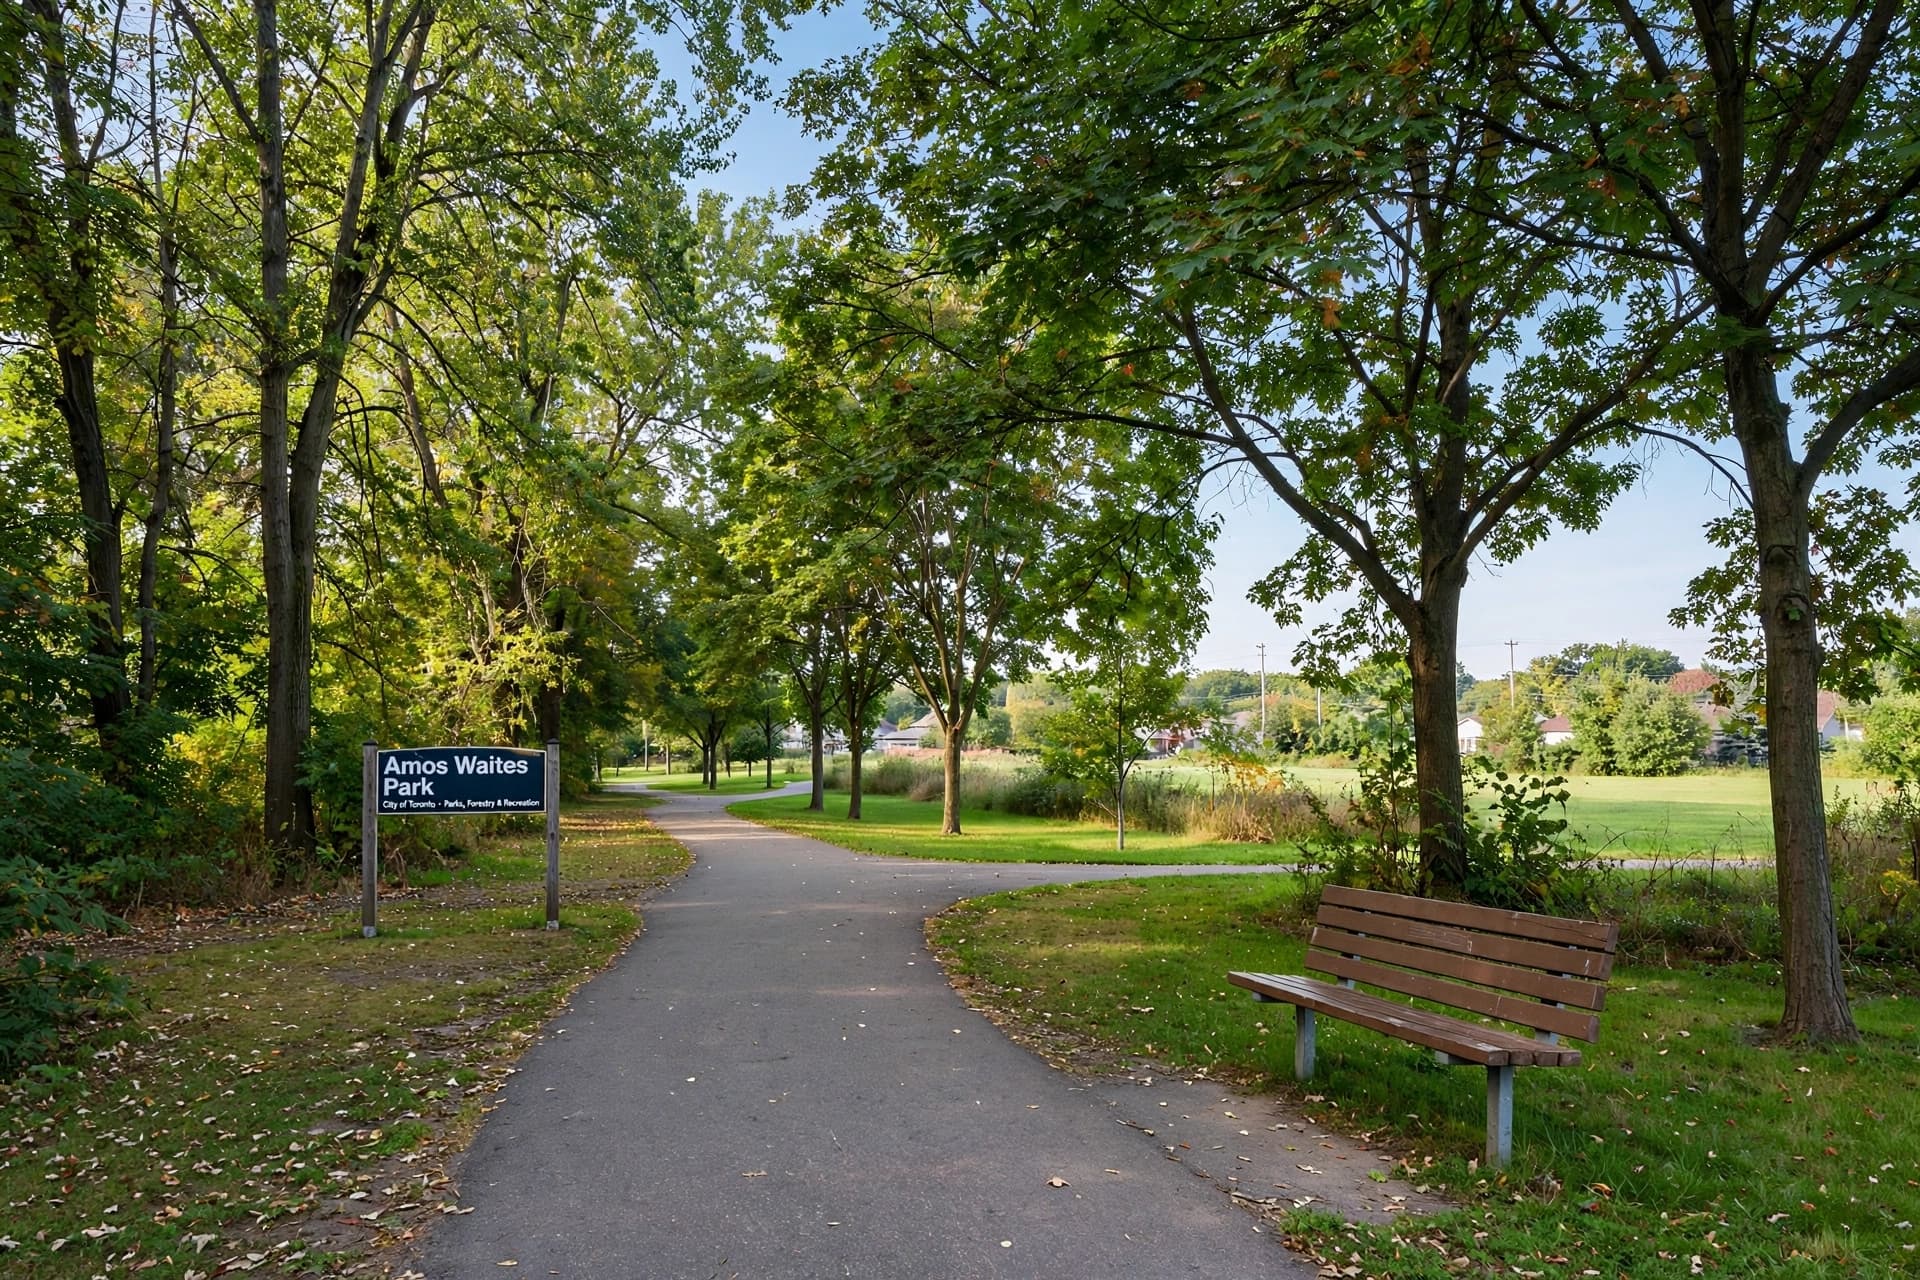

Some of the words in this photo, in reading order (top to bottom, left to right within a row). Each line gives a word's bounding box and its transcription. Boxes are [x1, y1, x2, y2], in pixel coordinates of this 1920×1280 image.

[383, 755, 449, 775] Amos
[454, 755, 529, 775] Waites
[383, 777, 434, 796] Park
[382, 800, 398, 810] City
[399, 800, 408, 809] of
[409, 799, 436, 809] Toronto
[467, 799, 495, 809] Forestry
[503, 798, 540, 808] Recreation
